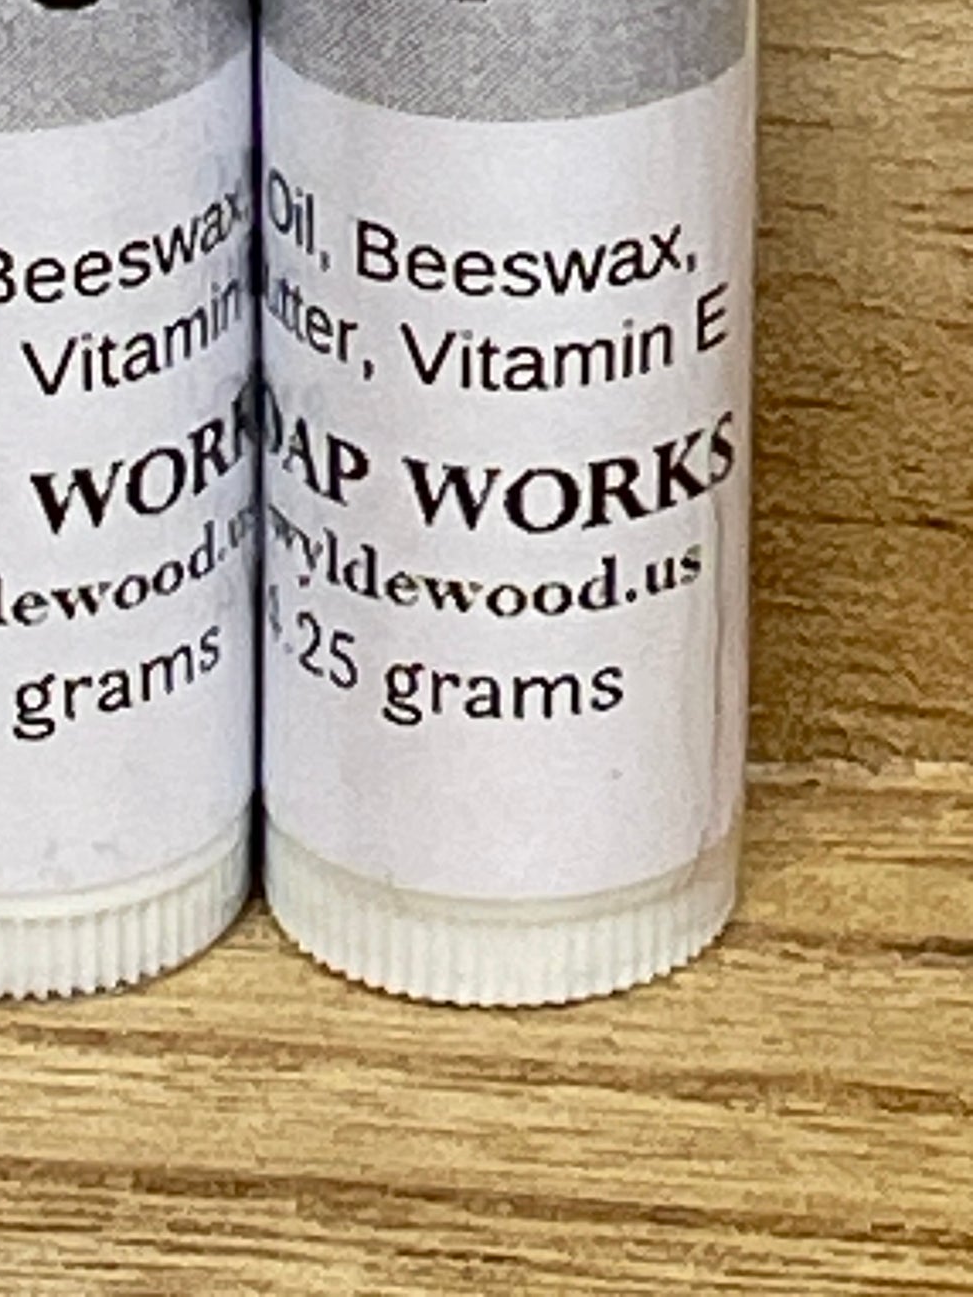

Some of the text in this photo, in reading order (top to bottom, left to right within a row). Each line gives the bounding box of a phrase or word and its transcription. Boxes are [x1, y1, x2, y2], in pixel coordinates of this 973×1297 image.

[269, 168, 697, 298] Oil, Beeswax,
[21, 277, 241, 396] Vitamin
[400, 319, 673, 392] Vitamin
[696, 281, 729, 352] E
[402, 411, 735, 535] WORKS
[12, 624, 222, 742] grams
[381, 662, 626, 727] grams
